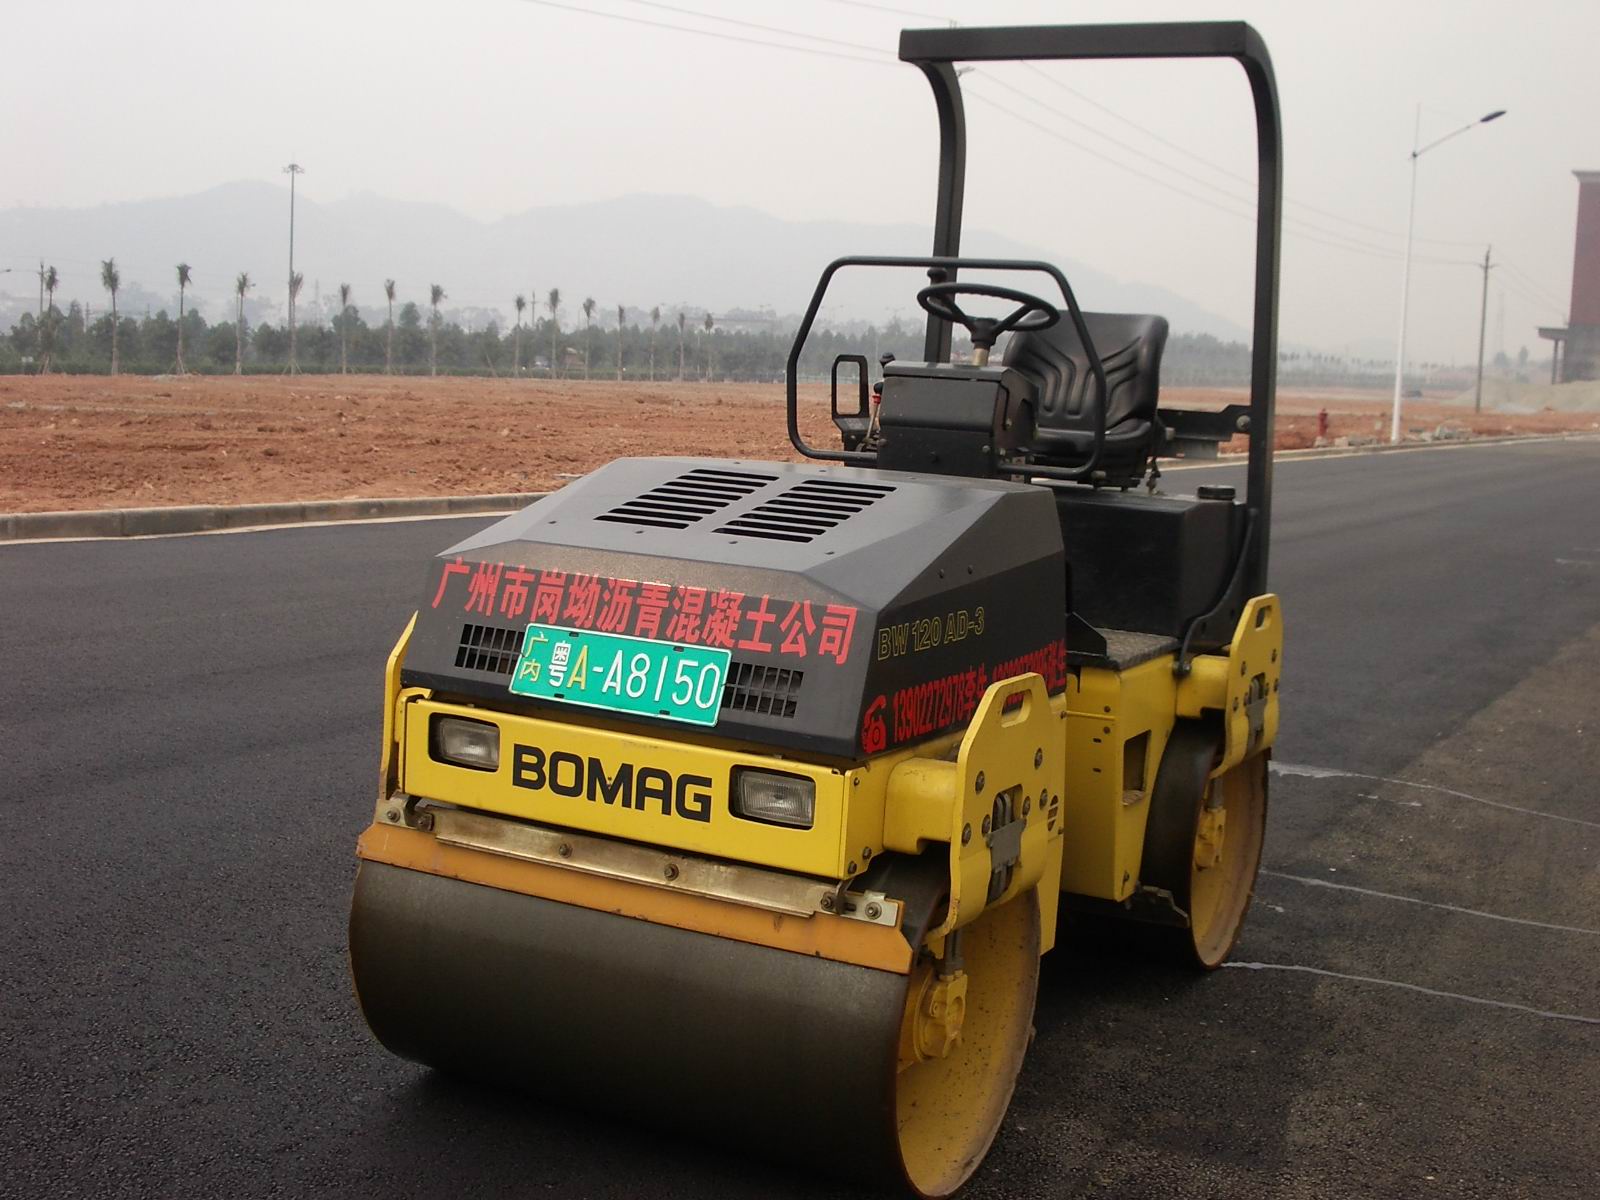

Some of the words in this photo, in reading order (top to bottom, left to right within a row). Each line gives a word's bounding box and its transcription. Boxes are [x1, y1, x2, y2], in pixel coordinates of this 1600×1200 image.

[432, 557, 857, 665] 广州市岗坳沥青混凝土公司
[878, 622, 909, 661] BW
[912, 616, 941, 652] 120
[944, 606, 985, 645] AD-3
[519, 630, 549, 683] 广内
[548, 640, 722, 710] 粤A-A8150
[512, 743, 713, 824] BOMAG
